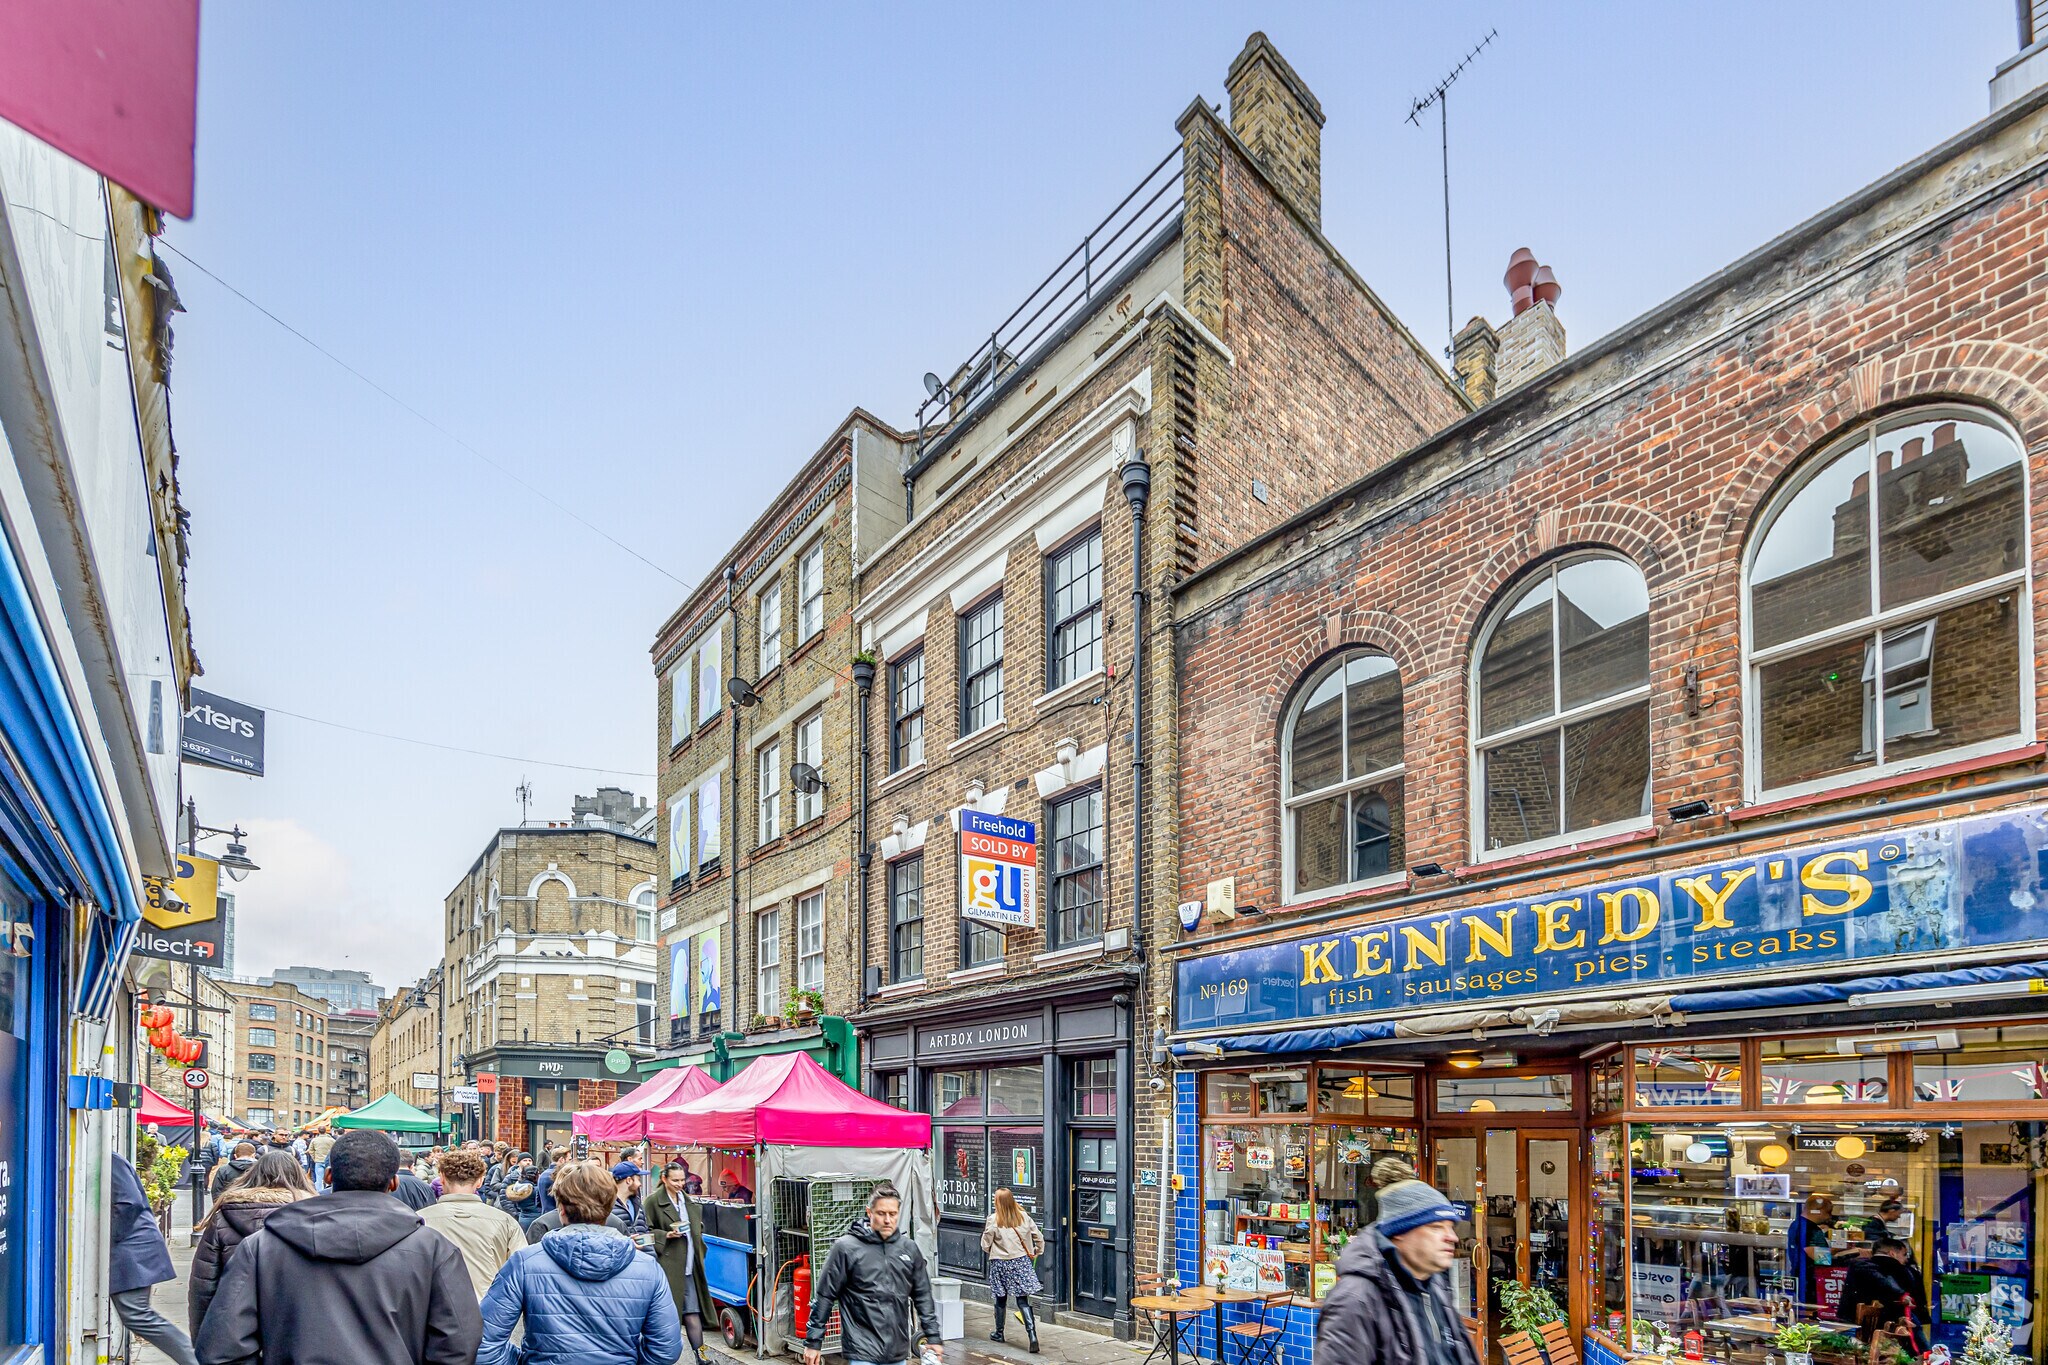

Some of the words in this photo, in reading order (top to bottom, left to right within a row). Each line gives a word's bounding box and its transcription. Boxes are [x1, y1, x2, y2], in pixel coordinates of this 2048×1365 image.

[184, 704, 255, 738] xters
[189, 742, 211, 755] 6372
[230, 755, 243, 764] Let
[244, 759, 255, 768] By
[972, 815, 1026, 839] Freehold
[971, 837, 1008, 855] SOLD
[1012, 845, 1029, 859] BY
[967, 907, 1008, 921] GILMARTIN
[1009, 913, 1022, 923] LEY
[1299, 848, 1873, 986] KENNEDY'S
[133, 932, 208, 958] llect+
[1328, 984, 1374, 1006] fish
[1404, 967, 1538, 997] sausages
[1573, 953, 1649, 982] pies
[1692, 928, 1838, 963] steaks
[929, 1032, 973, 1048] ARTBOX
[978, 1024, 1028, 1043] LONDON
[187, 1073, 206, 1083] 20
[936, 1179, 977, 1194] ARTBOX
[936, 1193, 977, 1207] LONDON
[1230, 1244, 1257, 1256] SEAFOOD
[1257, 1254, 1283, 1265] SEAFOOD
